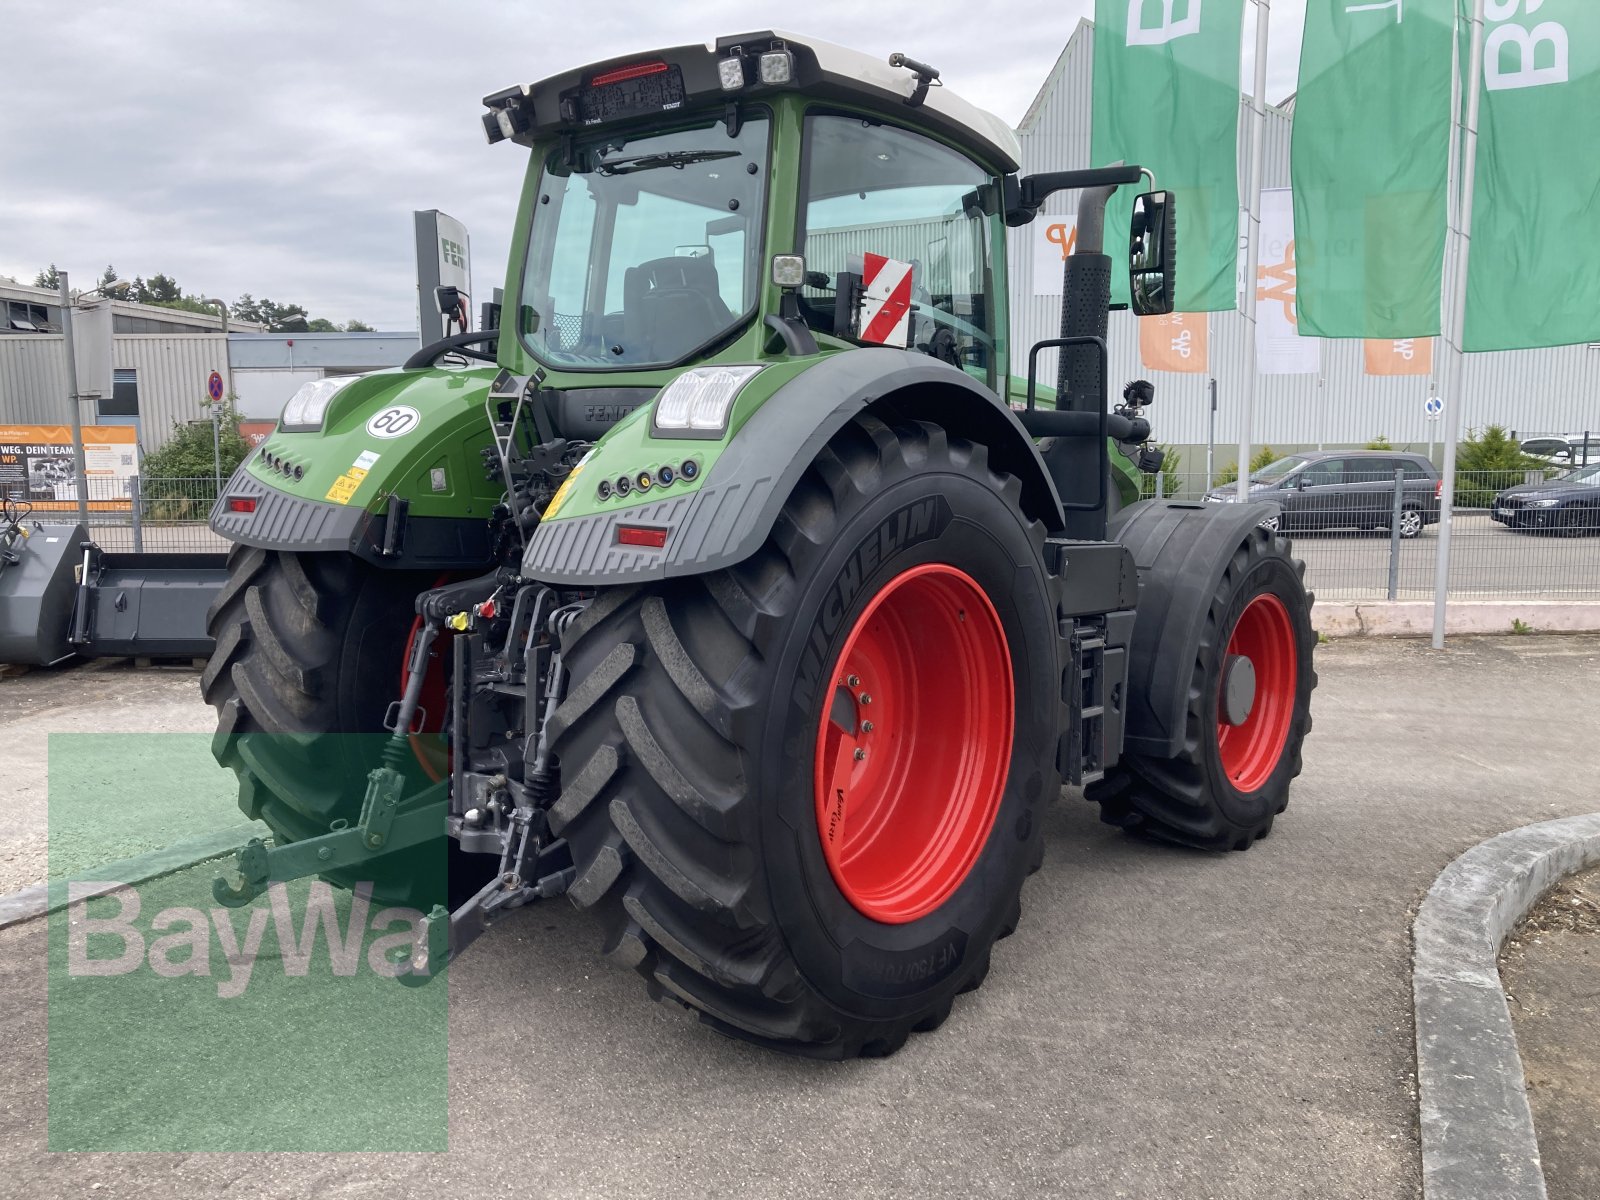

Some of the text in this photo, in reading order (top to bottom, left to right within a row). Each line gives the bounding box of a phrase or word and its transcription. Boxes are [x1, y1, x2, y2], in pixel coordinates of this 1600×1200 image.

[373, 409, 413, 434] 60
[1, 445, 23, 454] WEG.
[26, 446, 47, 454] DEIN
[50, 446, 74, 454] TEAM
[2, 455, 18, 464] WP.
[793, 499, 934, 713] MICHELIN
